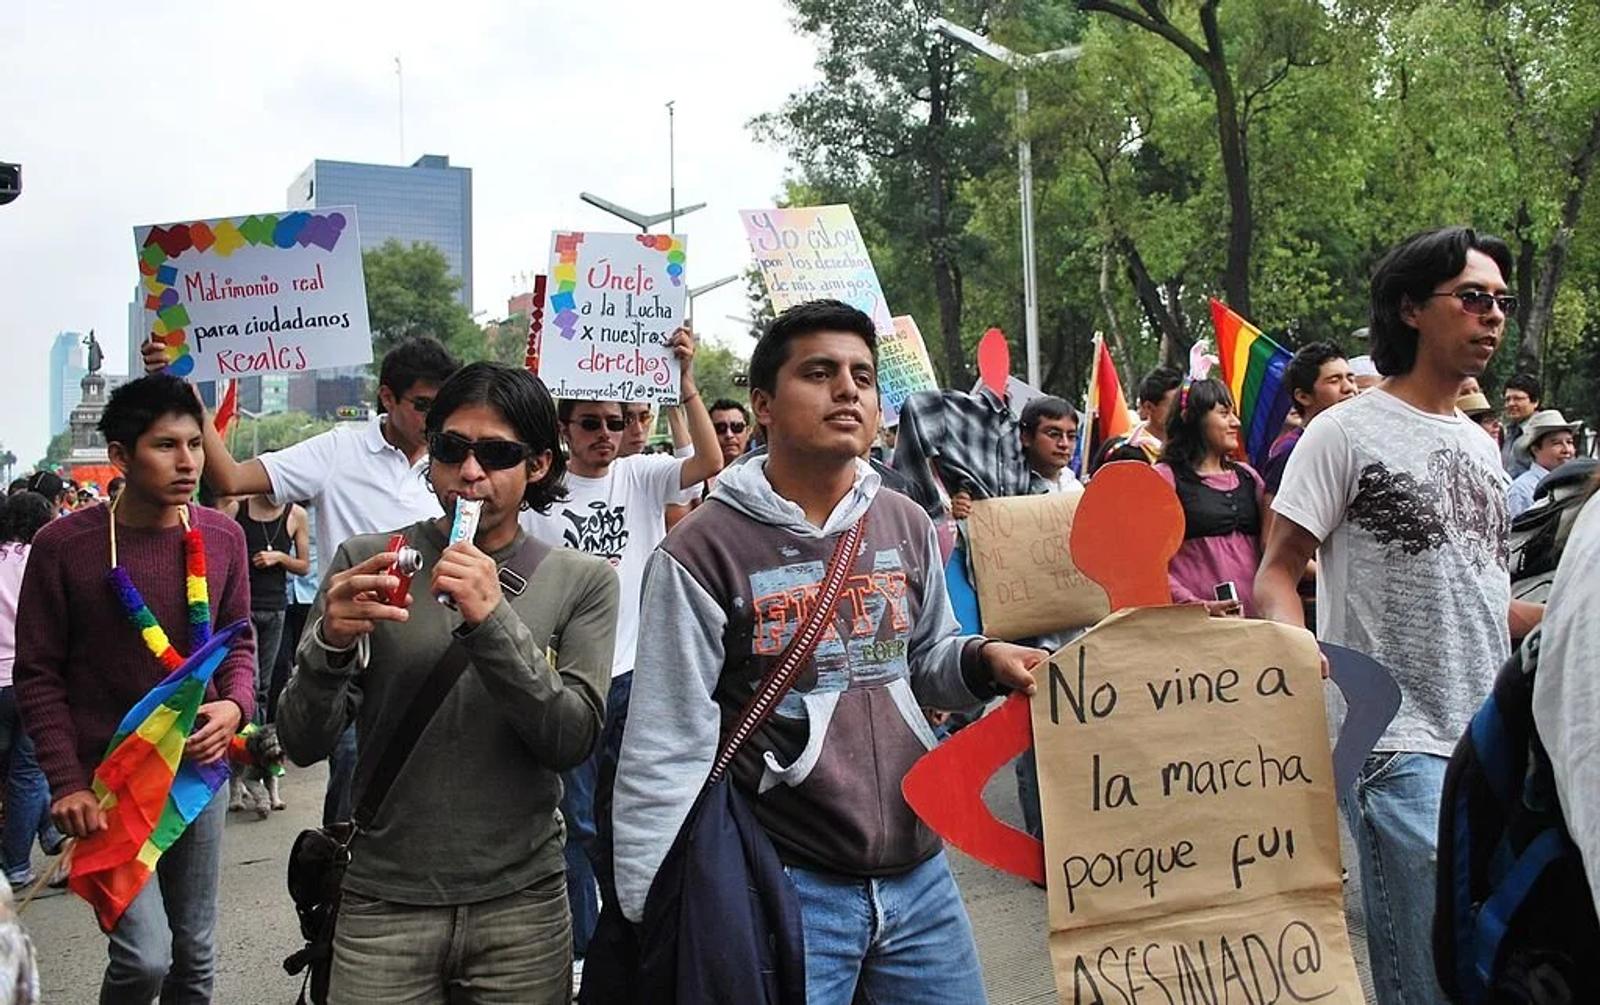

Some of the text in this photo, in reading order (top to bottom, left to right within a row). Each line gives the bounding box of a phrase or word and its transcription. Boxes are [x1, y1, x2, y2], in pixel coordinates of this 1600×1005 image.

[752, 212, 860, 254] Yo estoy
[587, 257, 654, 296] Únete
[787, 251, 813, 270] los
[814, 249, 871, 270] derechos
[185, 263, 324, 302] Matrimonio real
[820, 277, 872, 298] amigos
[581, 291, 672, 319] a la Lucha
[194, 304, 350, 353] para ciudadanos
[216, 335, 306, 375] Reales
[974, 500, 1073, 540] NO VIN
[978, 546, 1007, 574] ME
[996, 578, 1036, 605] DEL
[1049, 645, 1294, 725] No vine a
[1092, 744, 1313, 812] la marcha
[1063, 839, 1197, 914] porque
[1073, 920, 1338, 1005] ASESINAD@
